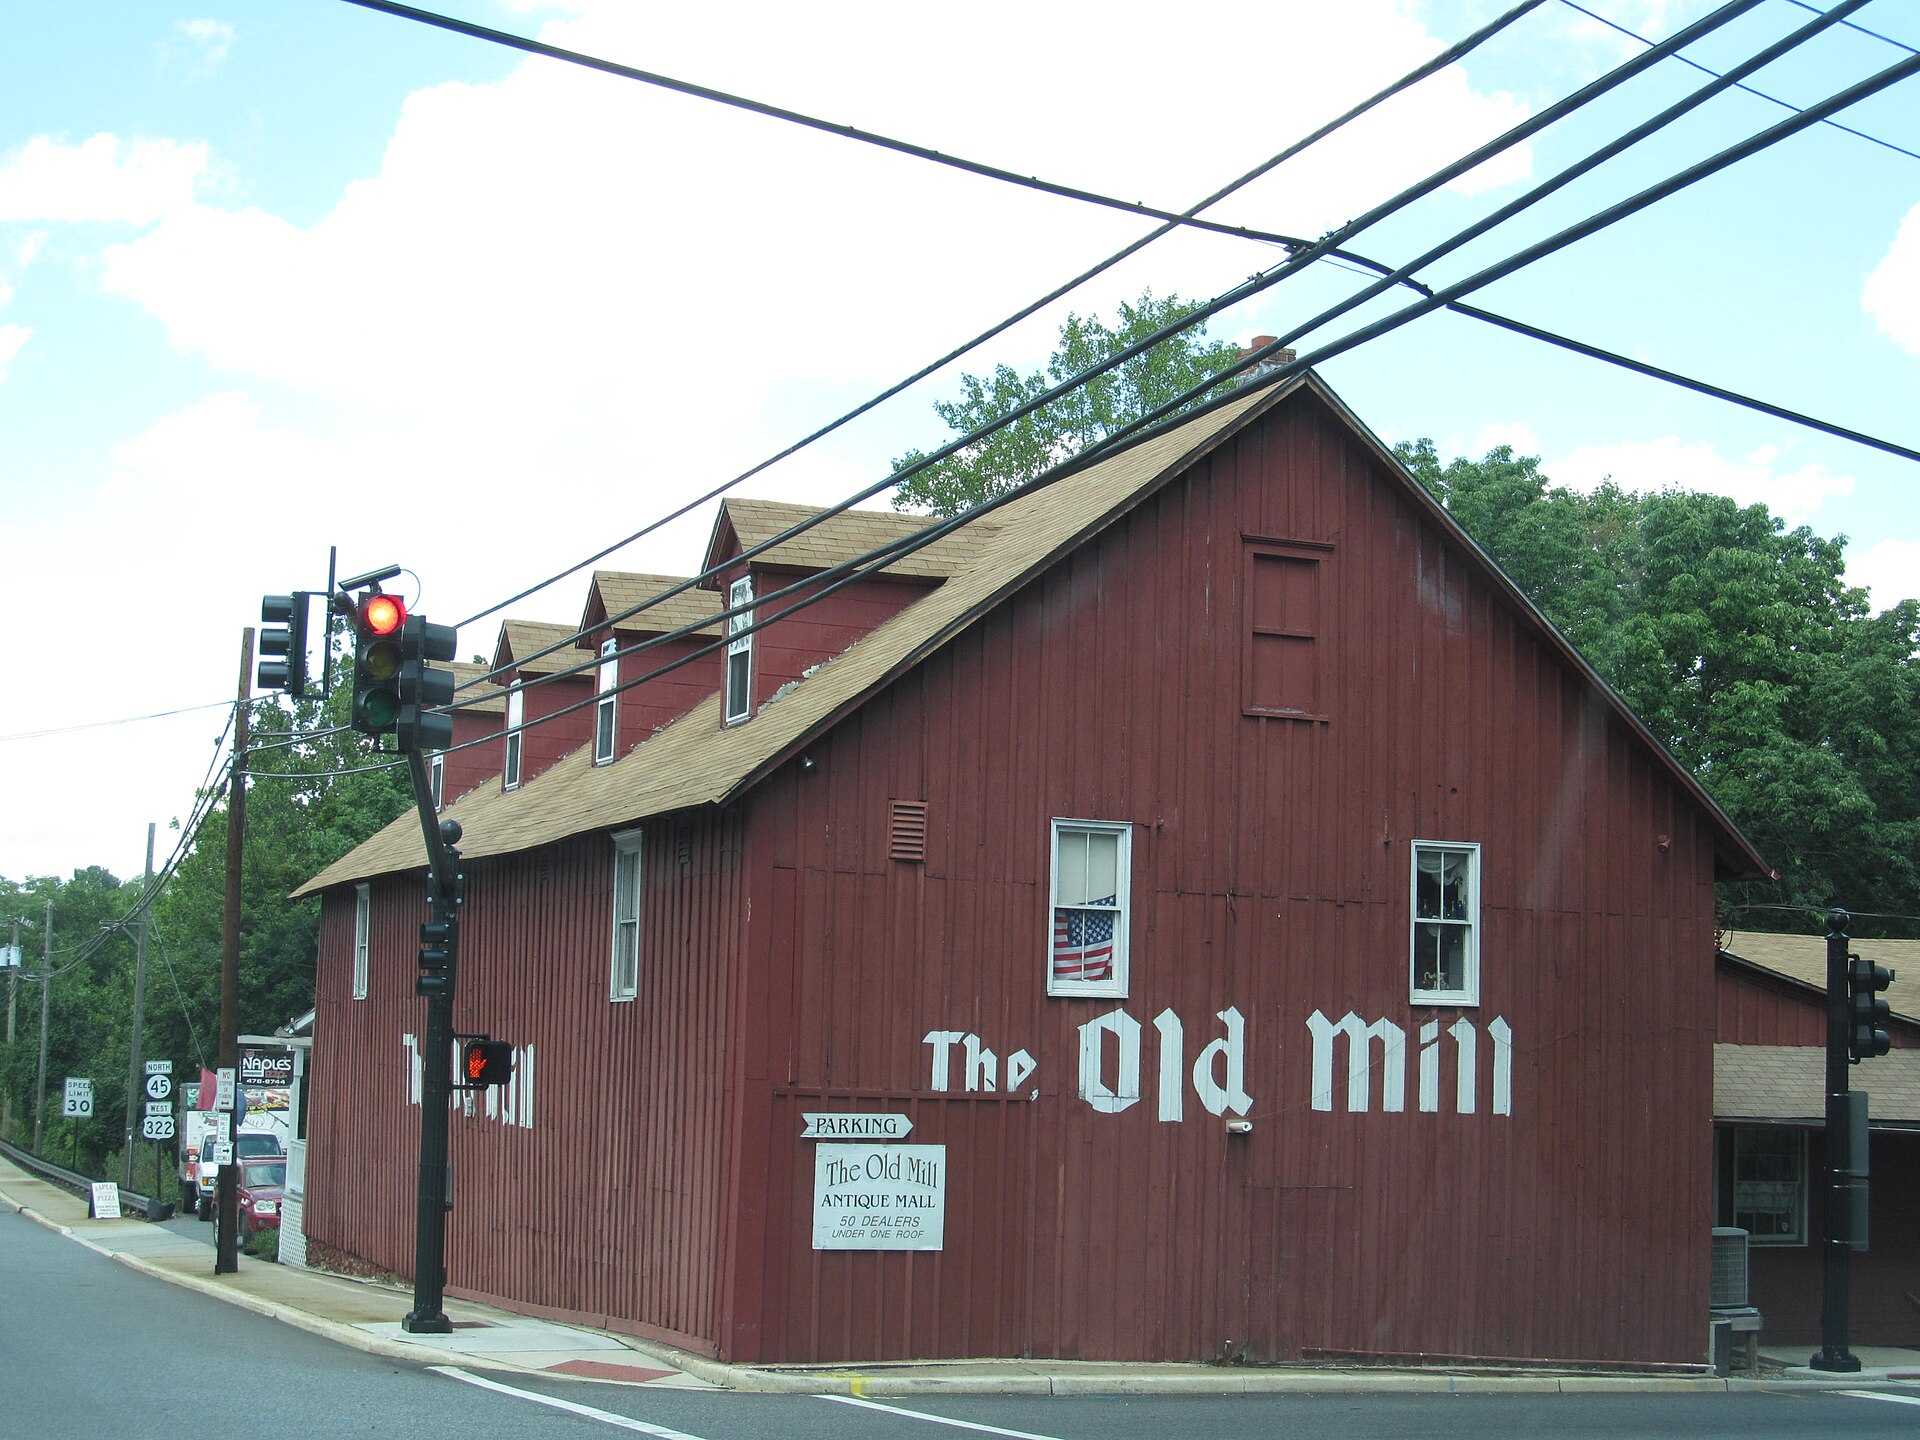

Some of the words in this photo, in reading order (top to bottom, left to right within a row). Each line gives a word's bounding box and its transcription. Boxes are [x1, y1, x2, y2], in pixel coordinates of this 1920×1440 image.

[147, 1063, 171, 1071] NORTH
[922, 1030, 1037, 1101] The
[1077, 1006, 1253, 1123] Old
[68, 1081, 92, 1089] SPEED
[150, 1080, 168, 1093] 45
[67, 1099, 90, 1112] 30
[145, 1120, 172, 1135] 322
[816, 1118, 897, 1134] PARKING
[826, 1158, 861, 1187] The
[866, 1153, 901, 1180] Old
[907, 1156, 938, 1189] Mill
[821, 1194, 890, 1209] ANTIQUE
[895, 1194, 936, 1209] MALL
[839, 1215, 856, 1227] 50
[861, 1216, 921, 1227] DEALERS
[832, 1229, 865, 1239] UNDER
[870, 1230, 891, 1239] ONE
[896, 1230, 925, 1239] ROOF
